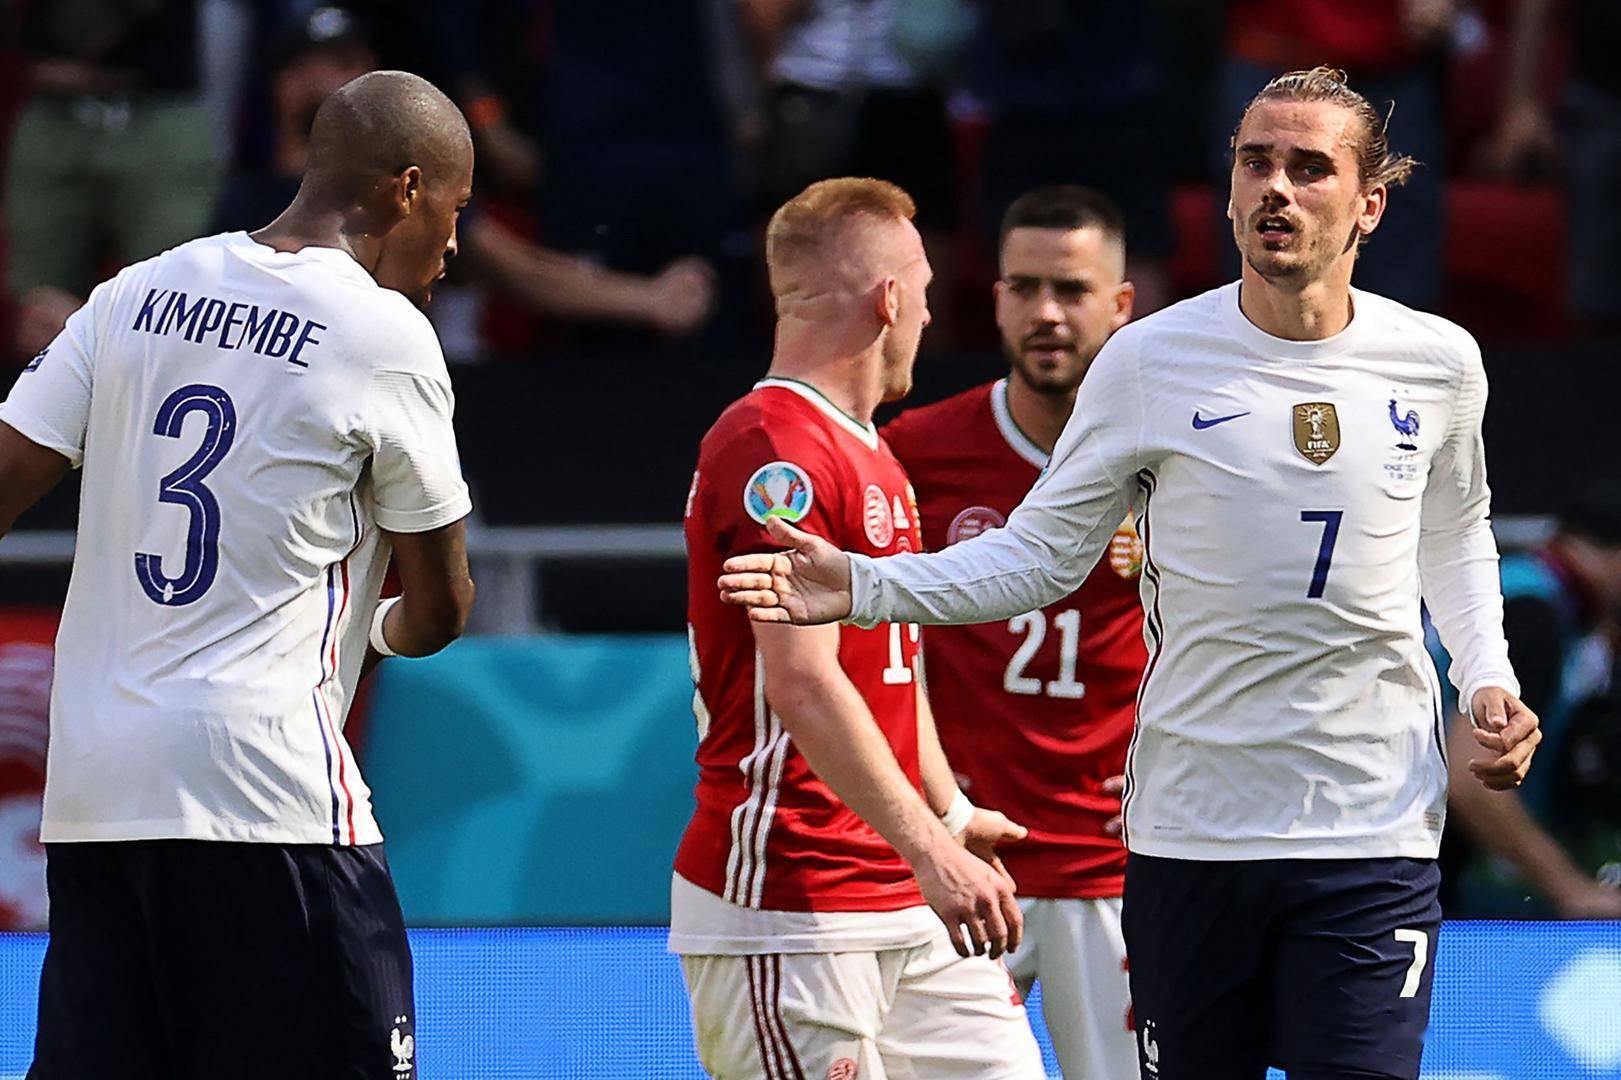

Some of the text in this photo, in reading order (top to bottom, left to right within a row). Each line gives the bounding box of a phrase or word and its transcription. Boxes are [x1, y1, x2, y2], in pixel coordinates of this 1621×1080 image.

[132, 288, 328, 368] KIMPEMBE
[1307, 440, 1330, 450] FIFA
[134, 383, 238, 607] 3
[1300, 510, 1344, 599] 7
[1003, 608, 1086, 698] 21
[1394, 928, 1429, 998] 7
